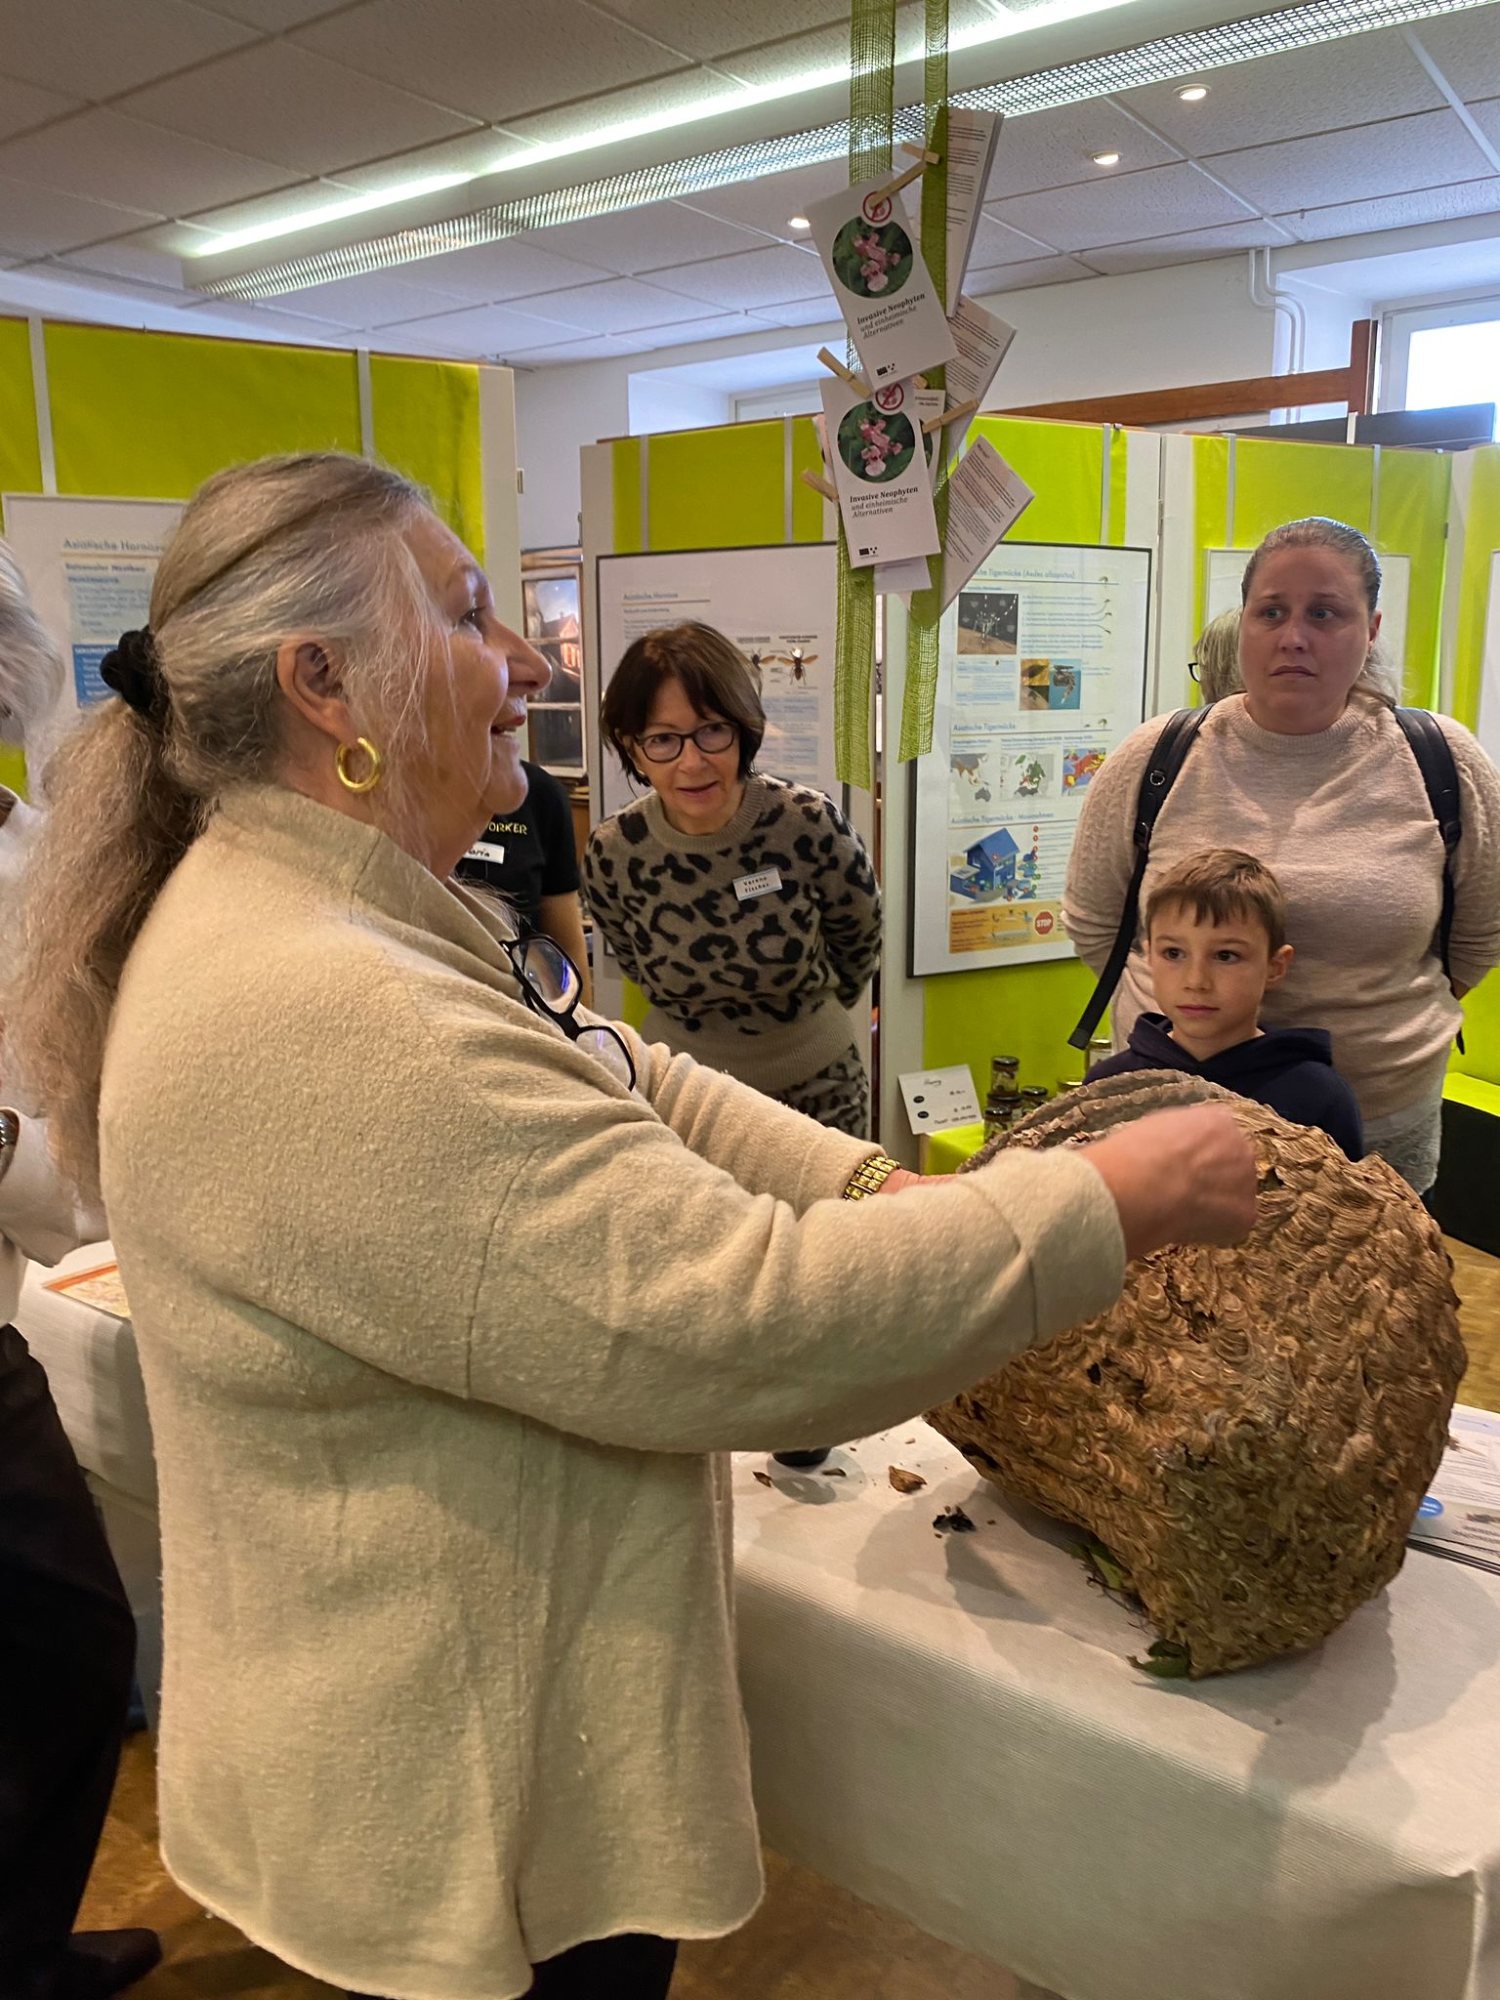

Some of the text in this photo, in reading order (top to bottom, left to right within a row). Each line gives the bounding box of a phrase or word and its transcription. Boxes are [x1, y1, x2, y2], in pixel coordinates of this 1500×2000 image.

[857, 293, 925, 325] Invasive Neophyten
[860, 305, 917, 332] und einheimische
[863, 318, 903, 339] Alternativen
[850, 486, 919, 503] Invasive Neophyten
[851, 497, 908, 511] und einheimische
[852, 507, 893, 518] Alternativen
[488, 822, 528, 835] ORKER
[1036, 919, 1052, 928] STOP
